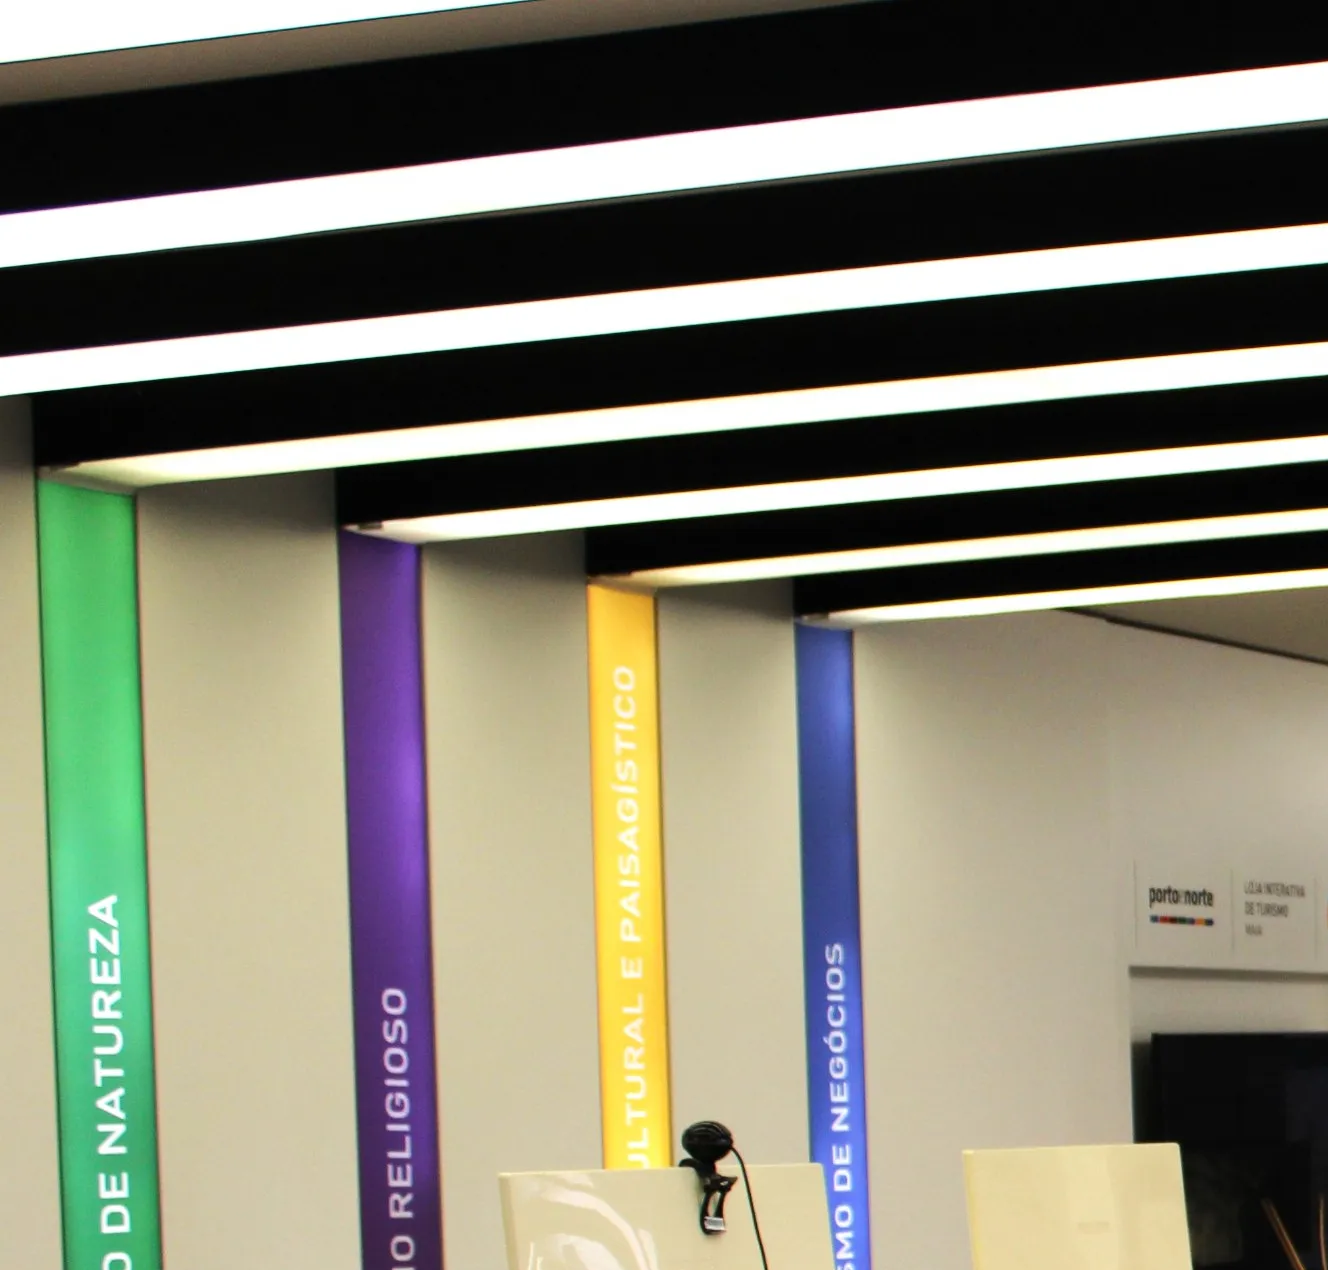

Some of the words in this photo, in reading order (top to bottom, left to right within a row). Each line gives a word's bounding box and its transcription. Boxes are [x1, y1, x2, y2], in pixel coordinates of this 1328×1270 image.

[611, 665, 642, 943] PAISAGÍSTICO
[87, 894, 128, 1155] NATUREZA
[621, 957, 643, 979] E
[823, 944, 850, 1132] NEGÓCIOS
[382, 988, 414, 1218] RELIGIOSO
[623, 993, 652, 1169] ULTURAL
[833, 1144, 852, 1188] DE
[98, 1172, 131, 1234] DE
